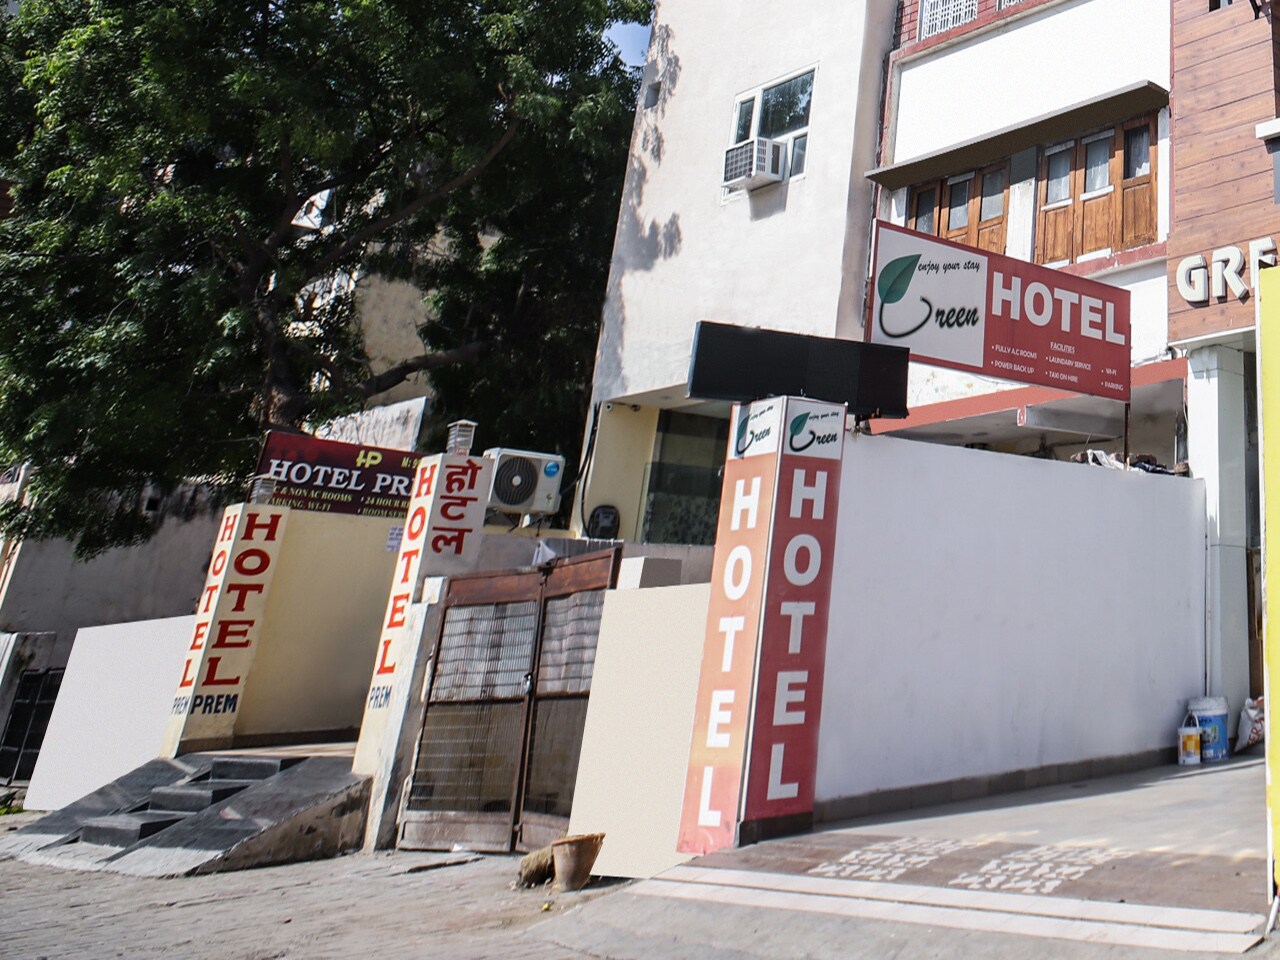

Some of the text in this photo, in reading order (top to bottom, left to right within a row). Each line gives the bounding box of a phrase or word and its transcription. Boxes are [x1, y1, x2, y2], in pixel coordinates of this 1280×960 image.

[918, 259, 981, 275] enjoy your stay
[992, 271, 1126, 346] HOTEL
[995, 344, 1011, 354] FULLY
[1020, 349, 1038, 359] ROOMS
[1050, 341, 1076, 354] FACILITIES
[994, 360, 1035, 374] POWER BACK UP
[1074, 360, 1092, 371] SERVICE
[1049, 370, 1078, 383] TAXI ON HIRE
[1104, 381, 1124, 391] PARKING
[268, 459, 414, 496] HOTEL PR
[271, 497, 305, 510] ARKING,
[289, 486, 308, 497] NON
[309, 488, 320, 498] AC
[322, 490, 352, 502] ROOMS
[375, 498, 401, 508] HOUR
[431, 460, 482, 555] होटल
[377, 463, 437, 675] HOTEL
[179, 513, 239, 688] HOTEL
[201, 513, 282, 687] HOTEL
[766, 468, 828, 800] HOTEL
[698, 476, 762, 827] HOTEL
[171, 695, 189, 715] PREM
[190, 694, 239, 715] PREM
[367, 685, 393, 709] PREM
